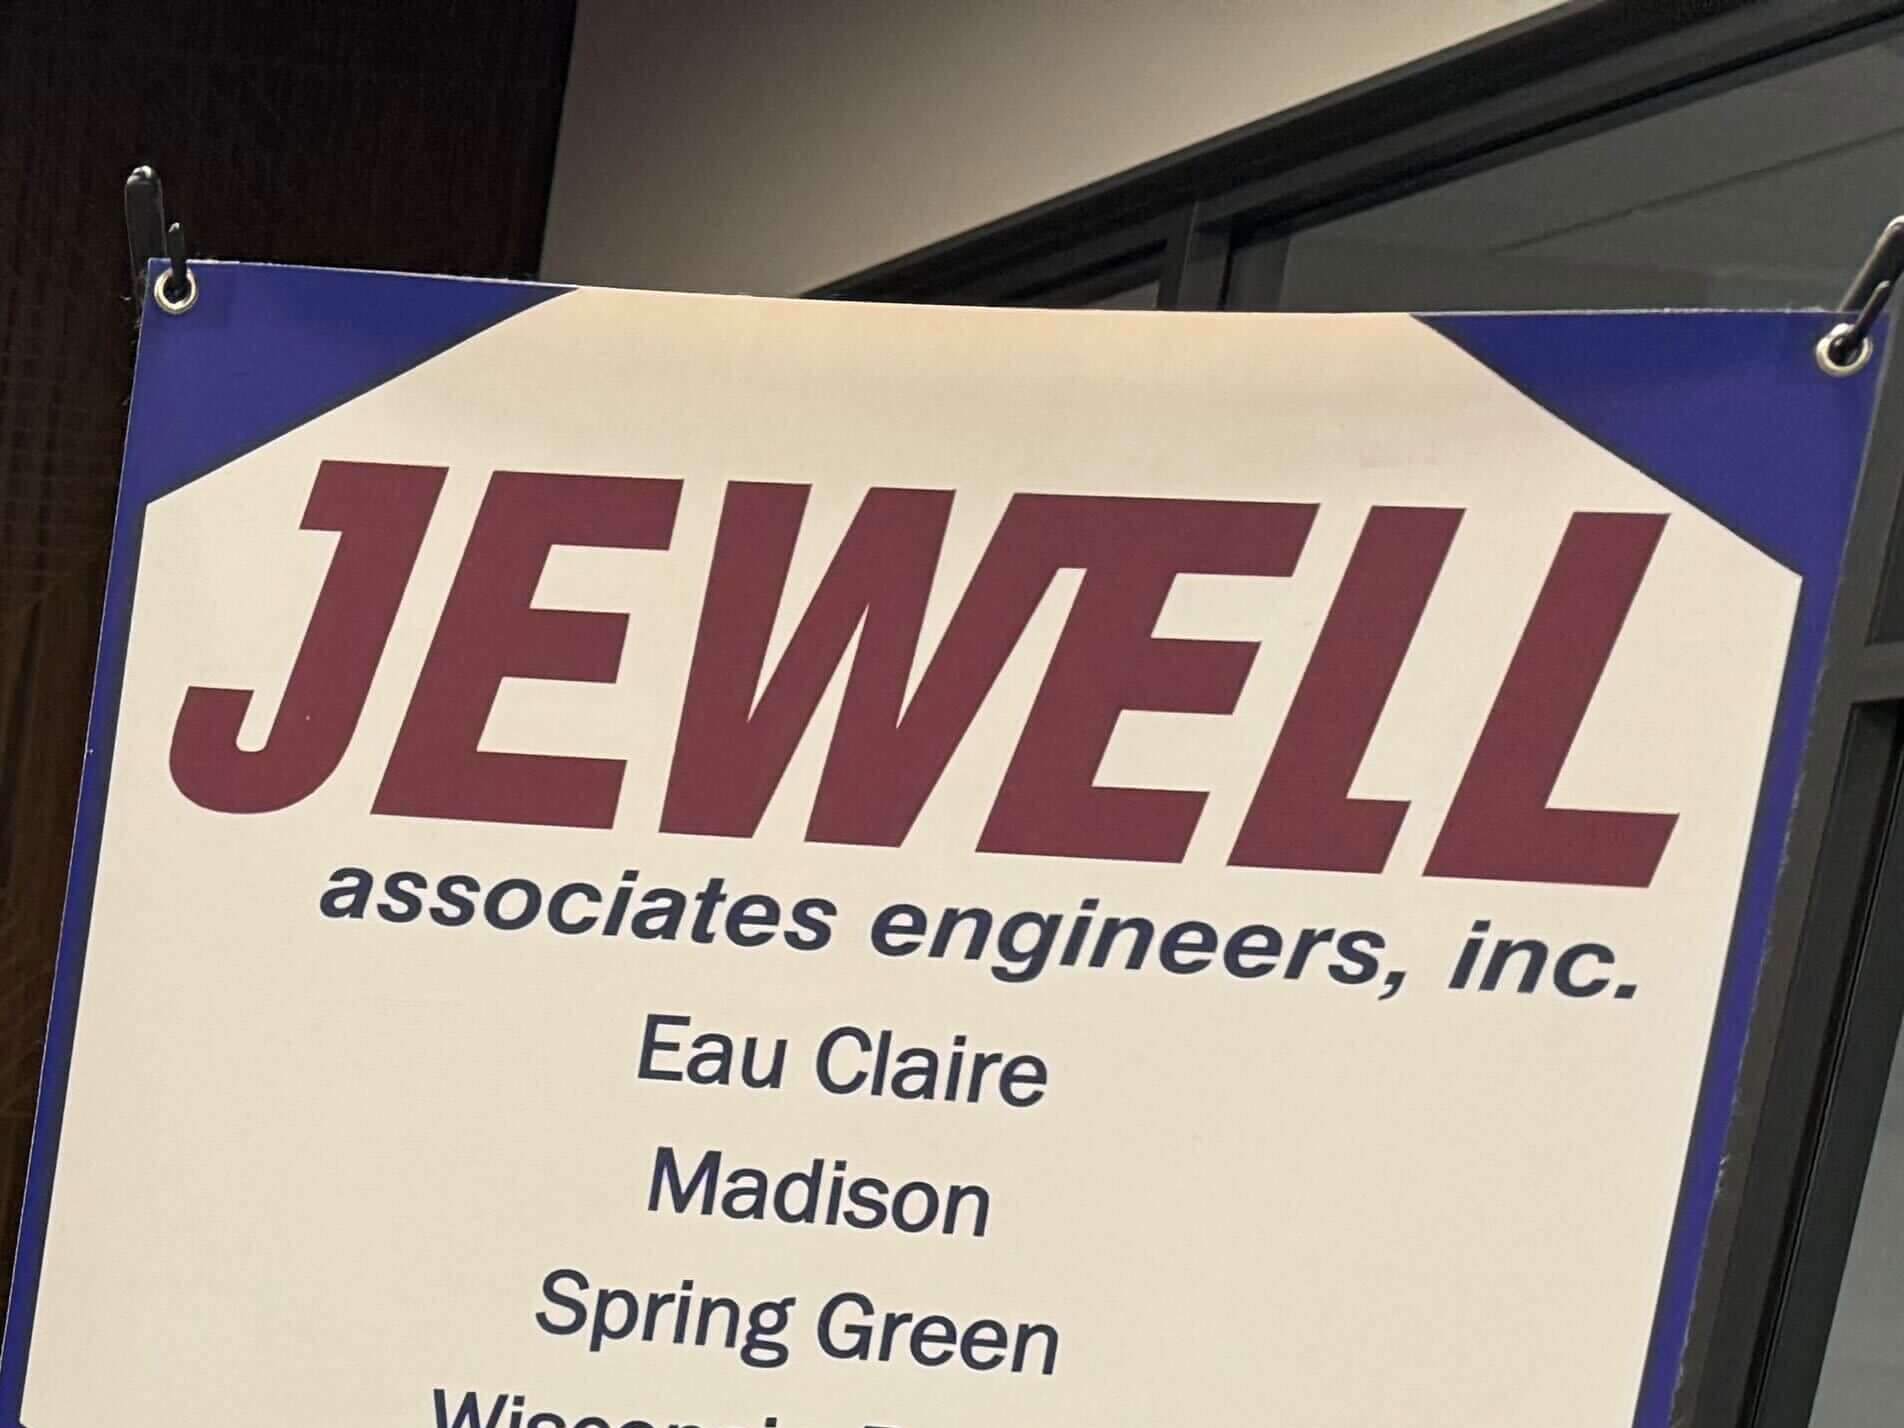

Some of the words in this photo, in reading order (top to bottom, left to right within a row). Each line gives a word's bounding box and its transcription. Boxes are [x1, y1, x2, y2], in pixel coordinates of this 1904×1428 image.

[168, 460, 1682, 889] JEWELL
[318, 866, 838, 952] associates
[869, 896, 1406, 1001] engineers,
[1447, 918, 1638, 1000] inc.
[637, 1013, 788, 1090] Eau
[815, 1026, 1048, 1109] Claire
[646, 1146, 990, 1238] Madison
[535, 1268, 798, 1369] Spring
[817, 1292, 1060, 1376] Green
